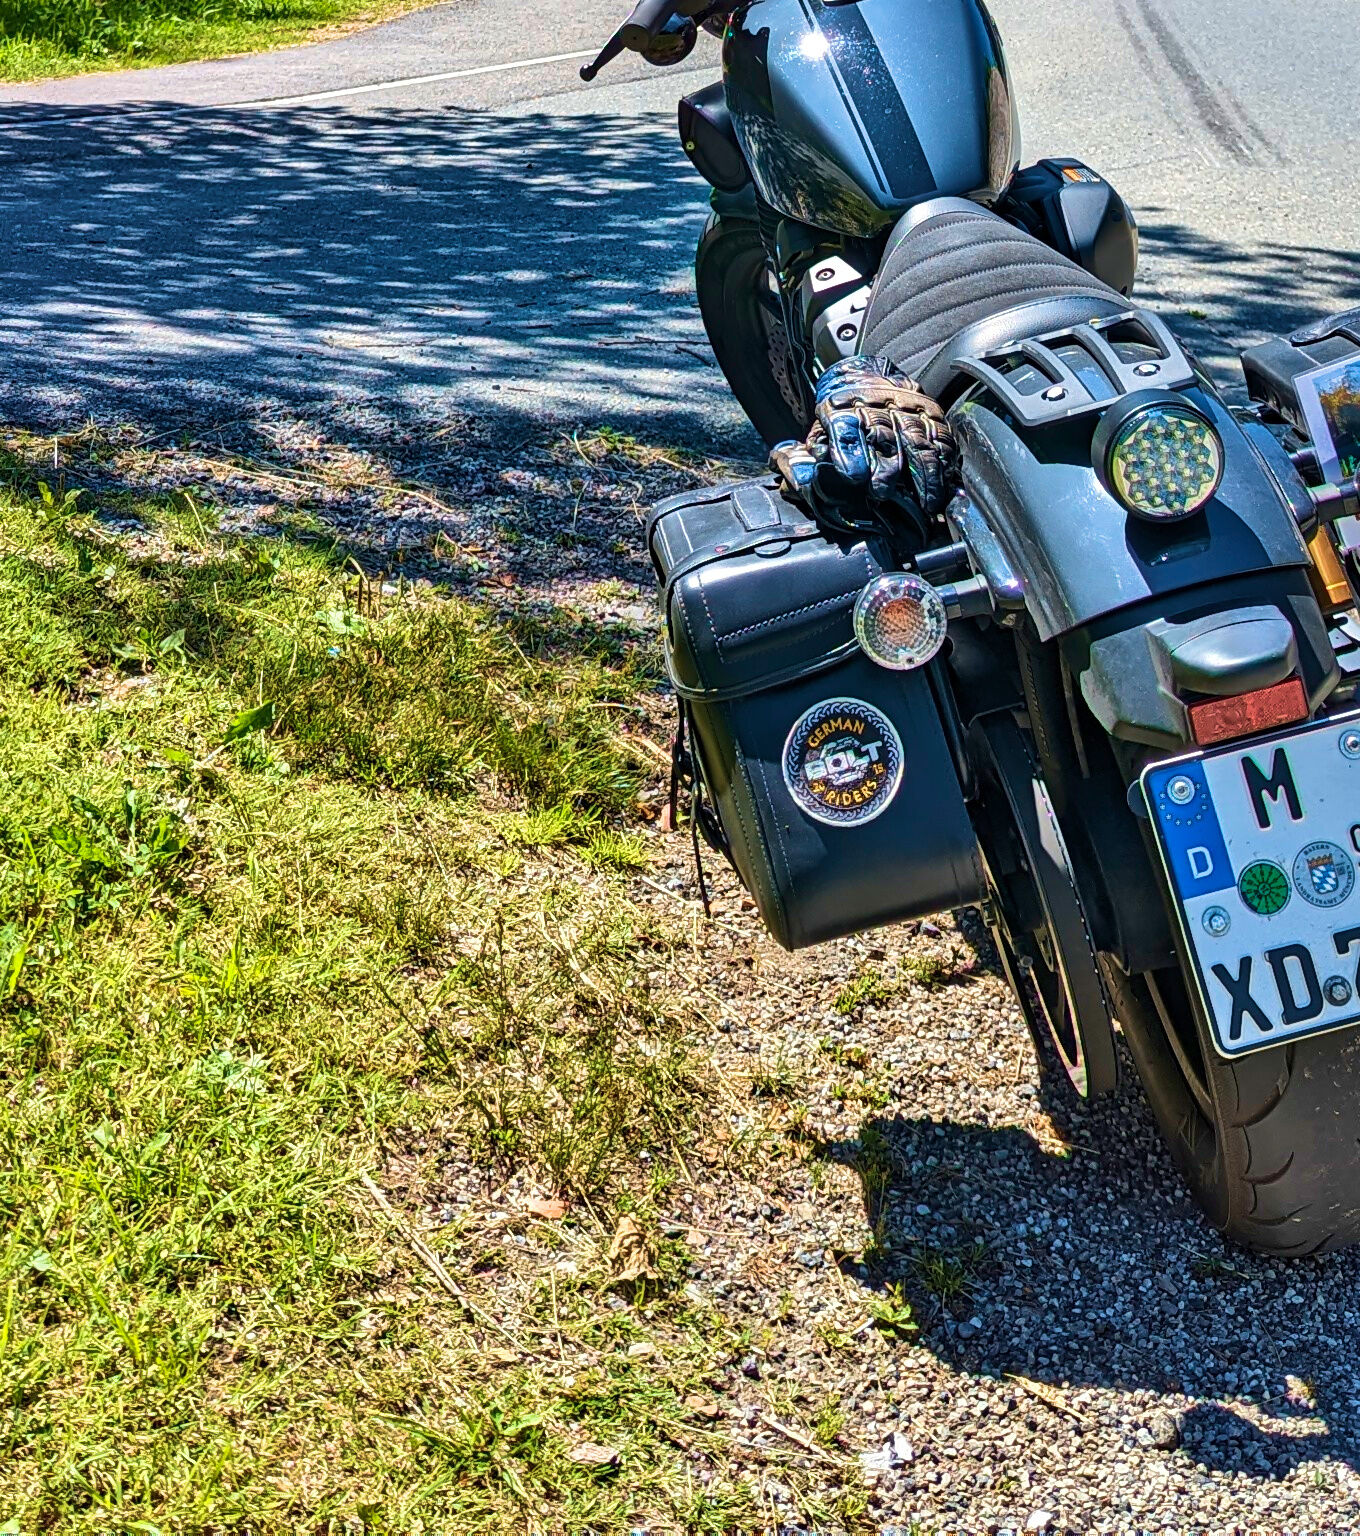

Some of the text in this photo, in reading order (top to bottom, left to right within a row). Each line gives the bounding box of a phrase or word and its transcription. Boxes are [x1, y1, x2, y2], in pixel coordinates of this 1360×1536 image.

[807, 717, 865, 748] GERMAN
[825, 780, 877, 806] RIDERS
[1241, 747, 1304, 829] M
[1186, 846, 1214, 880] D
[1211, 943, 1324, 1041] XD
